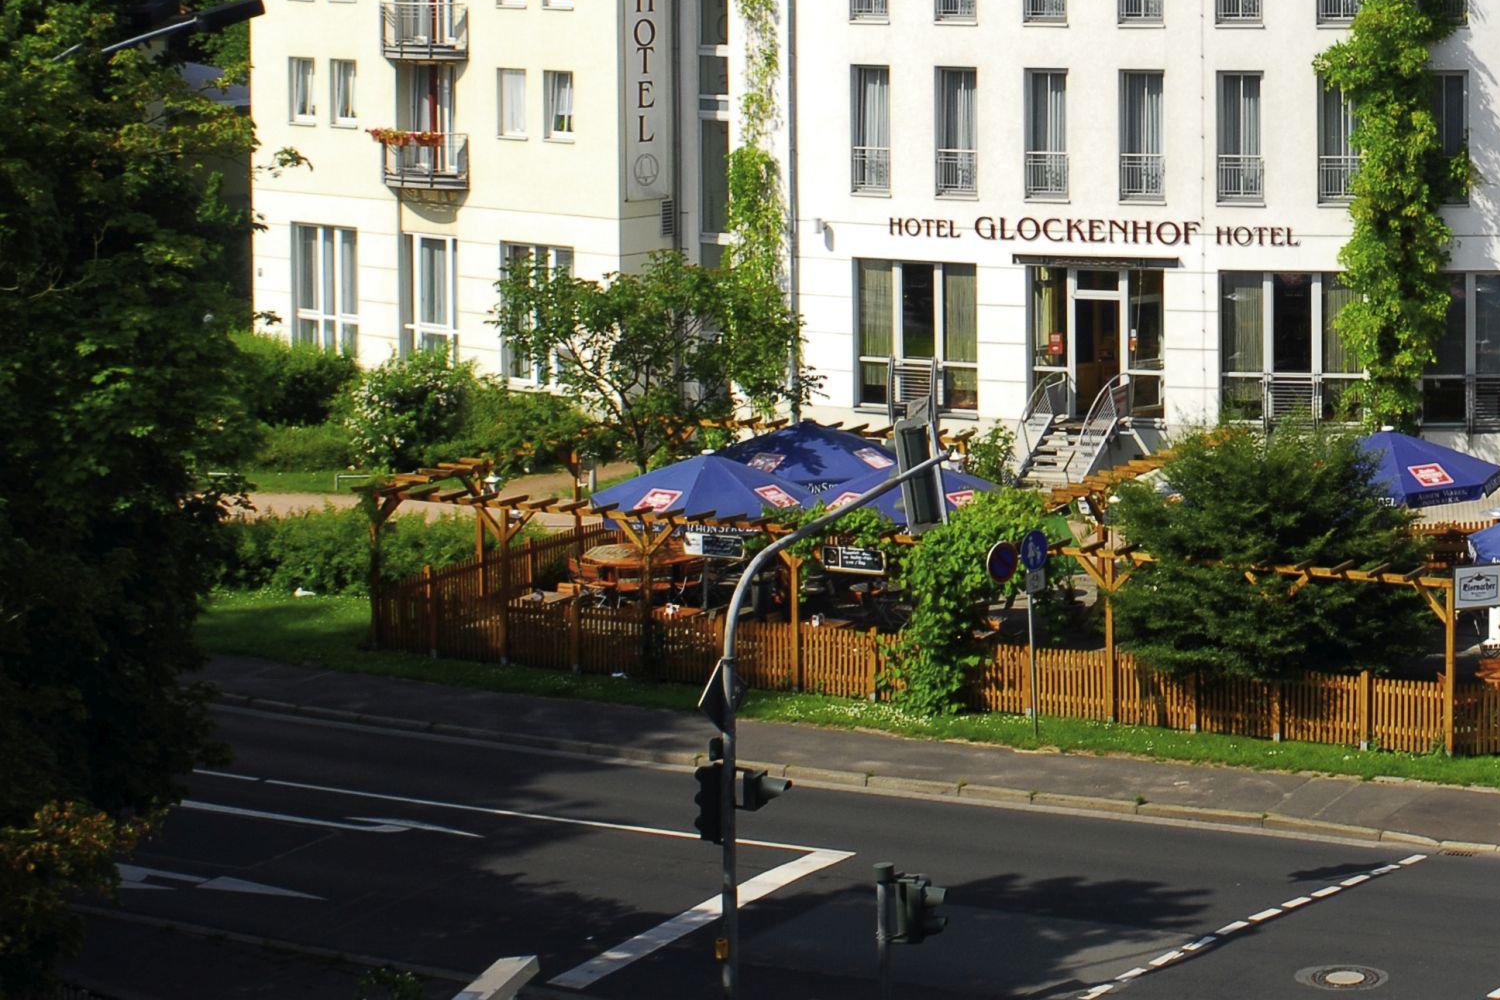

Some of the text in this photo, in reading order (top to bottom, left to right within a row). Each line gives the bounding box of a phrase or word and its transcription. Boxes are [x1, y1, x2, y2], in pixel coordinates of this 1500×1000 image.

[889, 217, 1301, 247] HOTEL GLOCKENHOF HOTEL
[1463, 581, 1496, 592] Eisenacher
